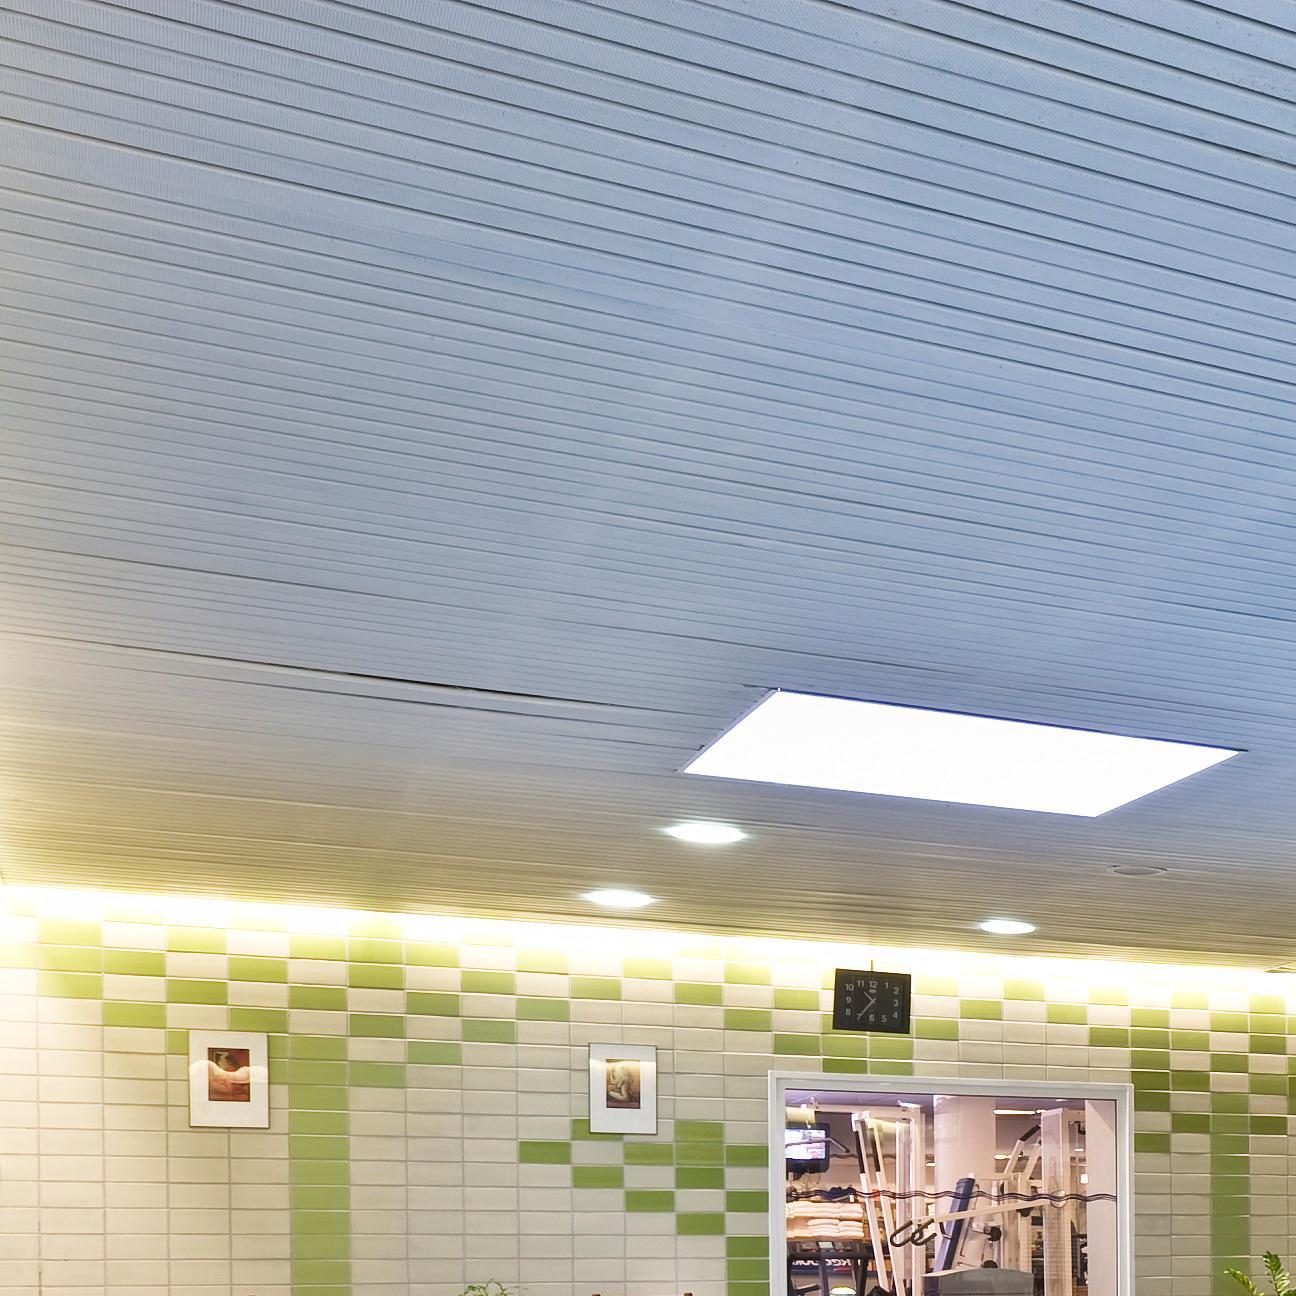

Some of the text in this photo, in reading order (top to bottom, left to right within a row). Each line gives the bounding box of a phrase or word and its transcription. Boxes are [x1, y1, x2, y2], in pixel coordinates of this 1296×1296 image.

[845, 983, 855, 992] 10
[869, 981, 878, 989] 12
[893, 987, 900, 995] 2
[881, 1015, 887, 1023] 5
[892, 1011, 898, 1019] 4
